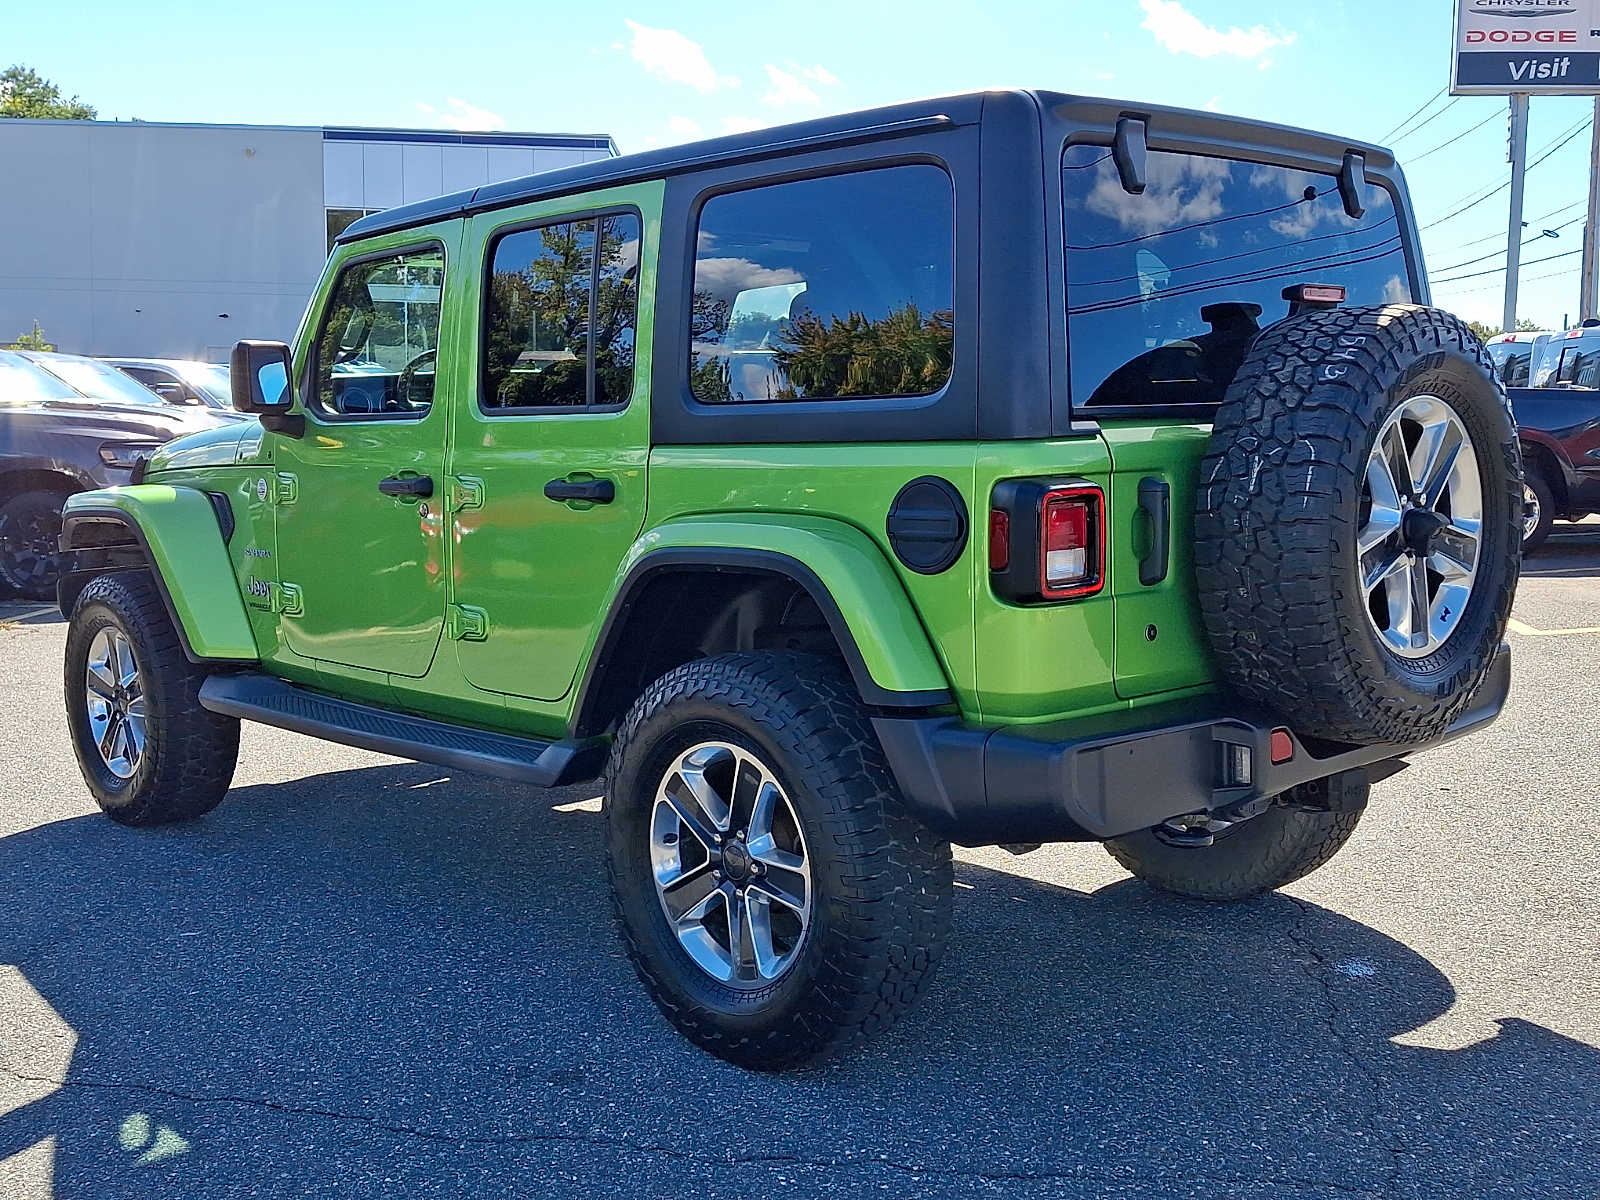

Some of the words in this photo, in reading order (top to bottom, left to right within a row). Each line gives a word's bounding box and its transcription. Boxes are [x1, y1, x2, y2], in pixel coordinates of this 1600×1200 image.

[1466, 30, 1577, 43] DODGE
[1508, 56, 1571, 81] Visit
[247, 575, 271, 602] Jeep
